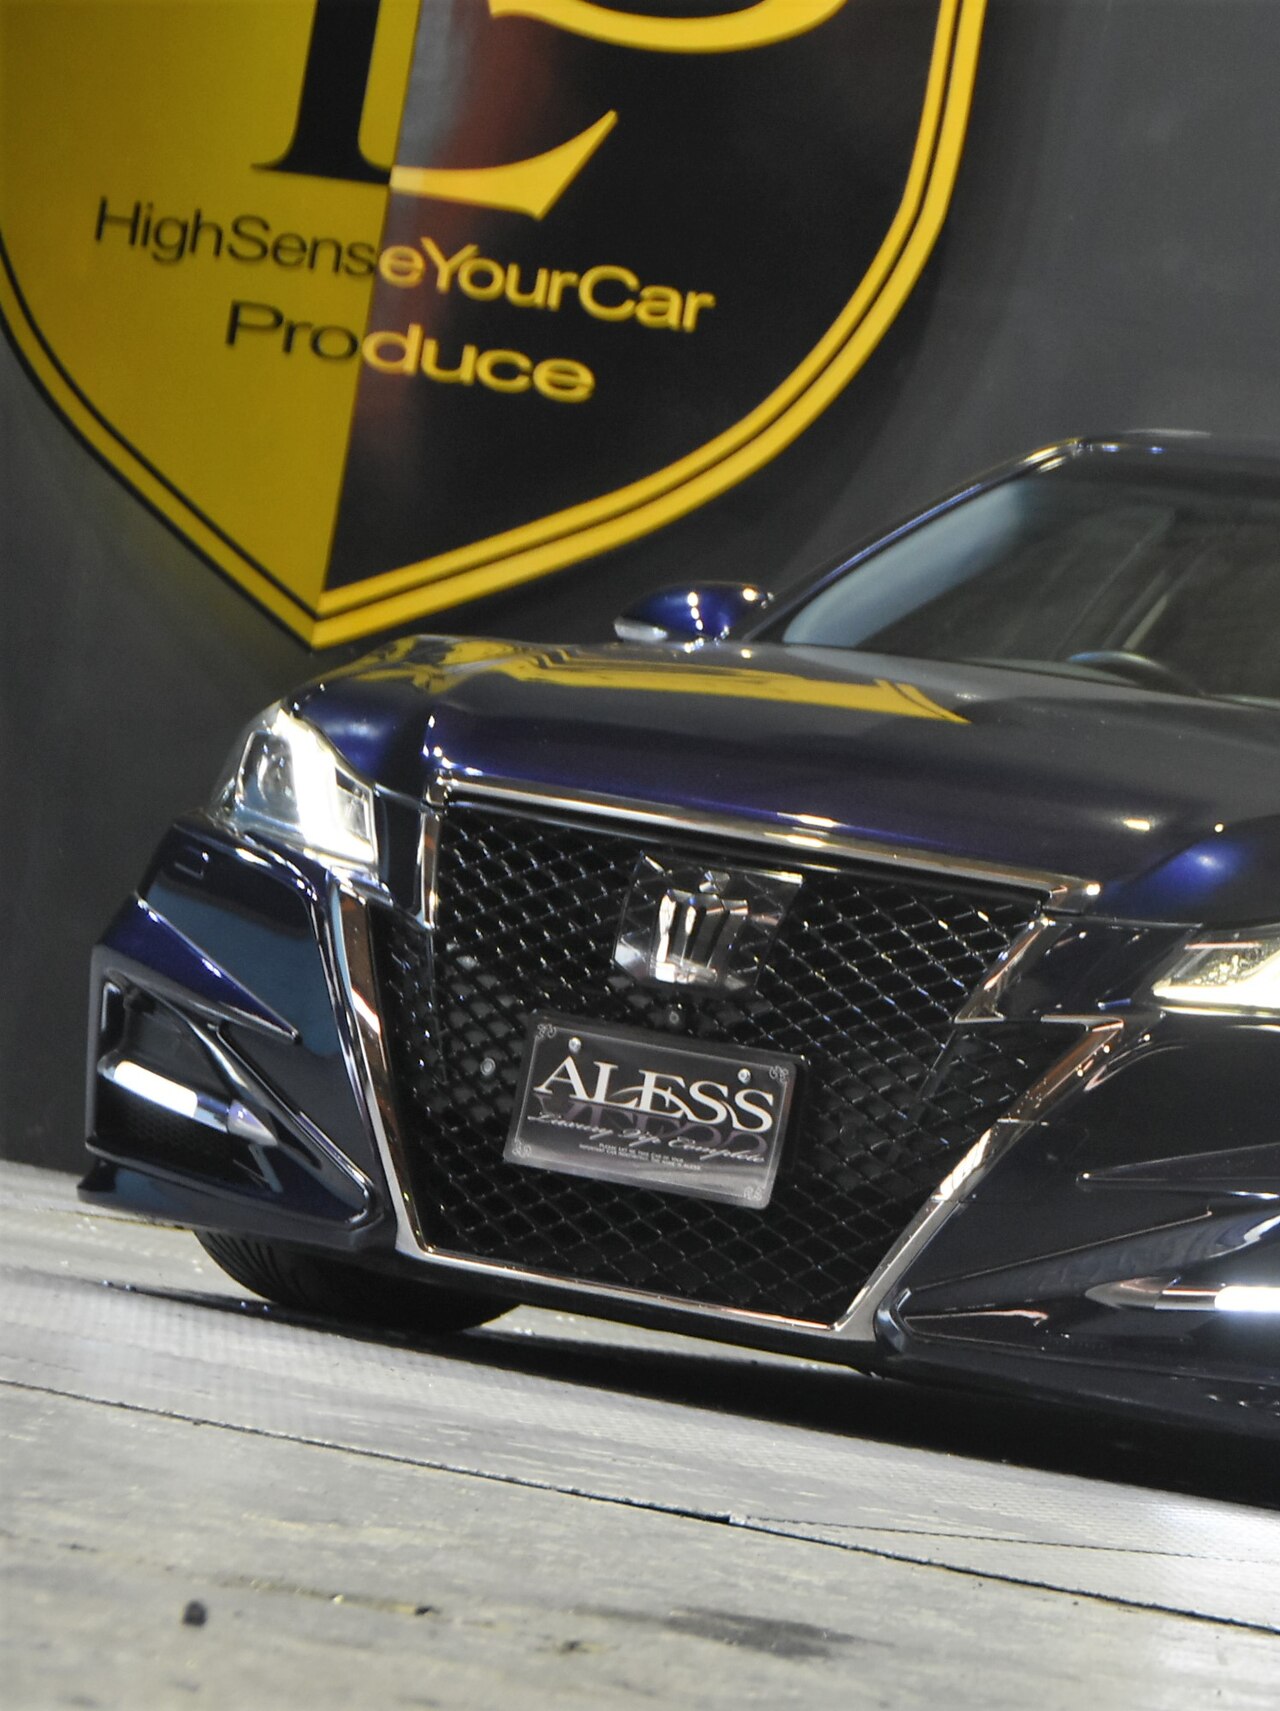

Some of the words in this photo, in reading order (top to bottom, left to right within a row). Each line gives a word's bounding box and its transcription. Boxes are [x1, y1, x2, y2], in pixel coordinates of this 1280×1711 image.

[94, 196, 715, 332] HighSenseYourCar
[225, 300, 596, 402] Produce
[533, 1055, 774, 1133] ALESS
